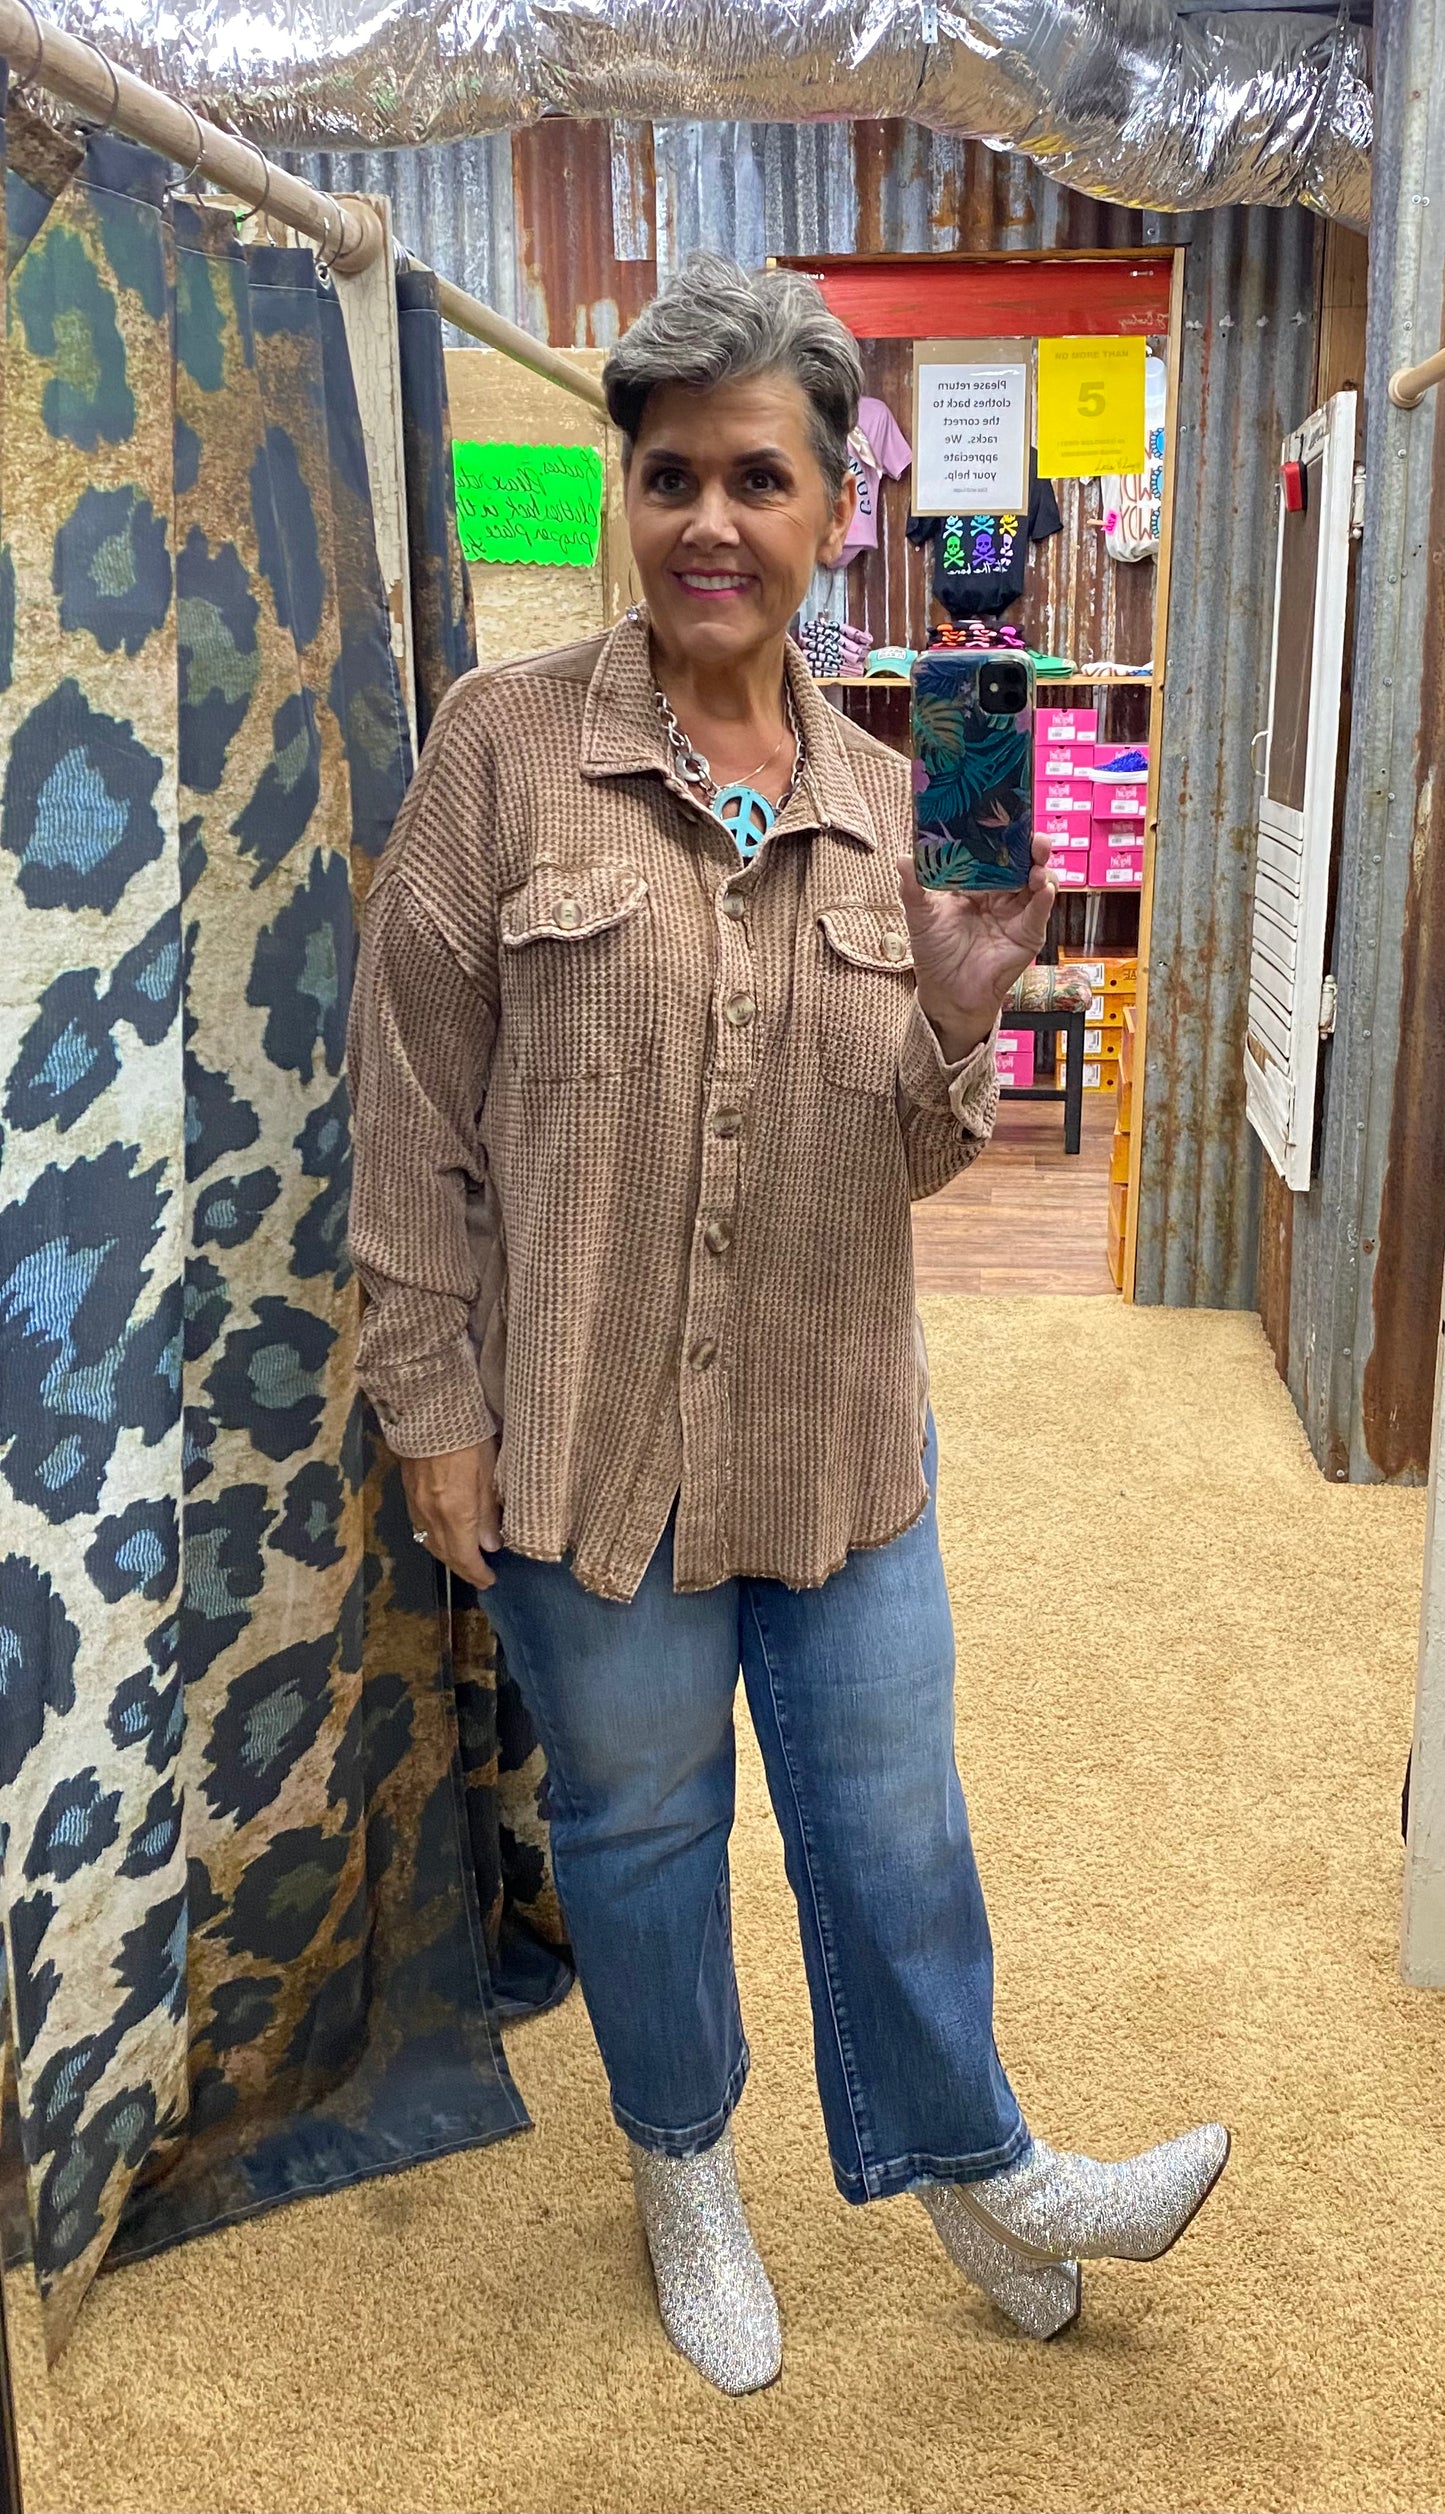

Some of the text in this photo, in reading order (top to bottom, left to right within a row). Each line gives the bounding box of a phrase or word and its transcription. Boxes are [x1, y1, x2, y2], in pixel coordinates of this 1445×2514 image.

[1072, 351, 1099, 359] MORE
[1102, 350, 1129, 358] THAN
[1077, 381, 1106, 417] 5
